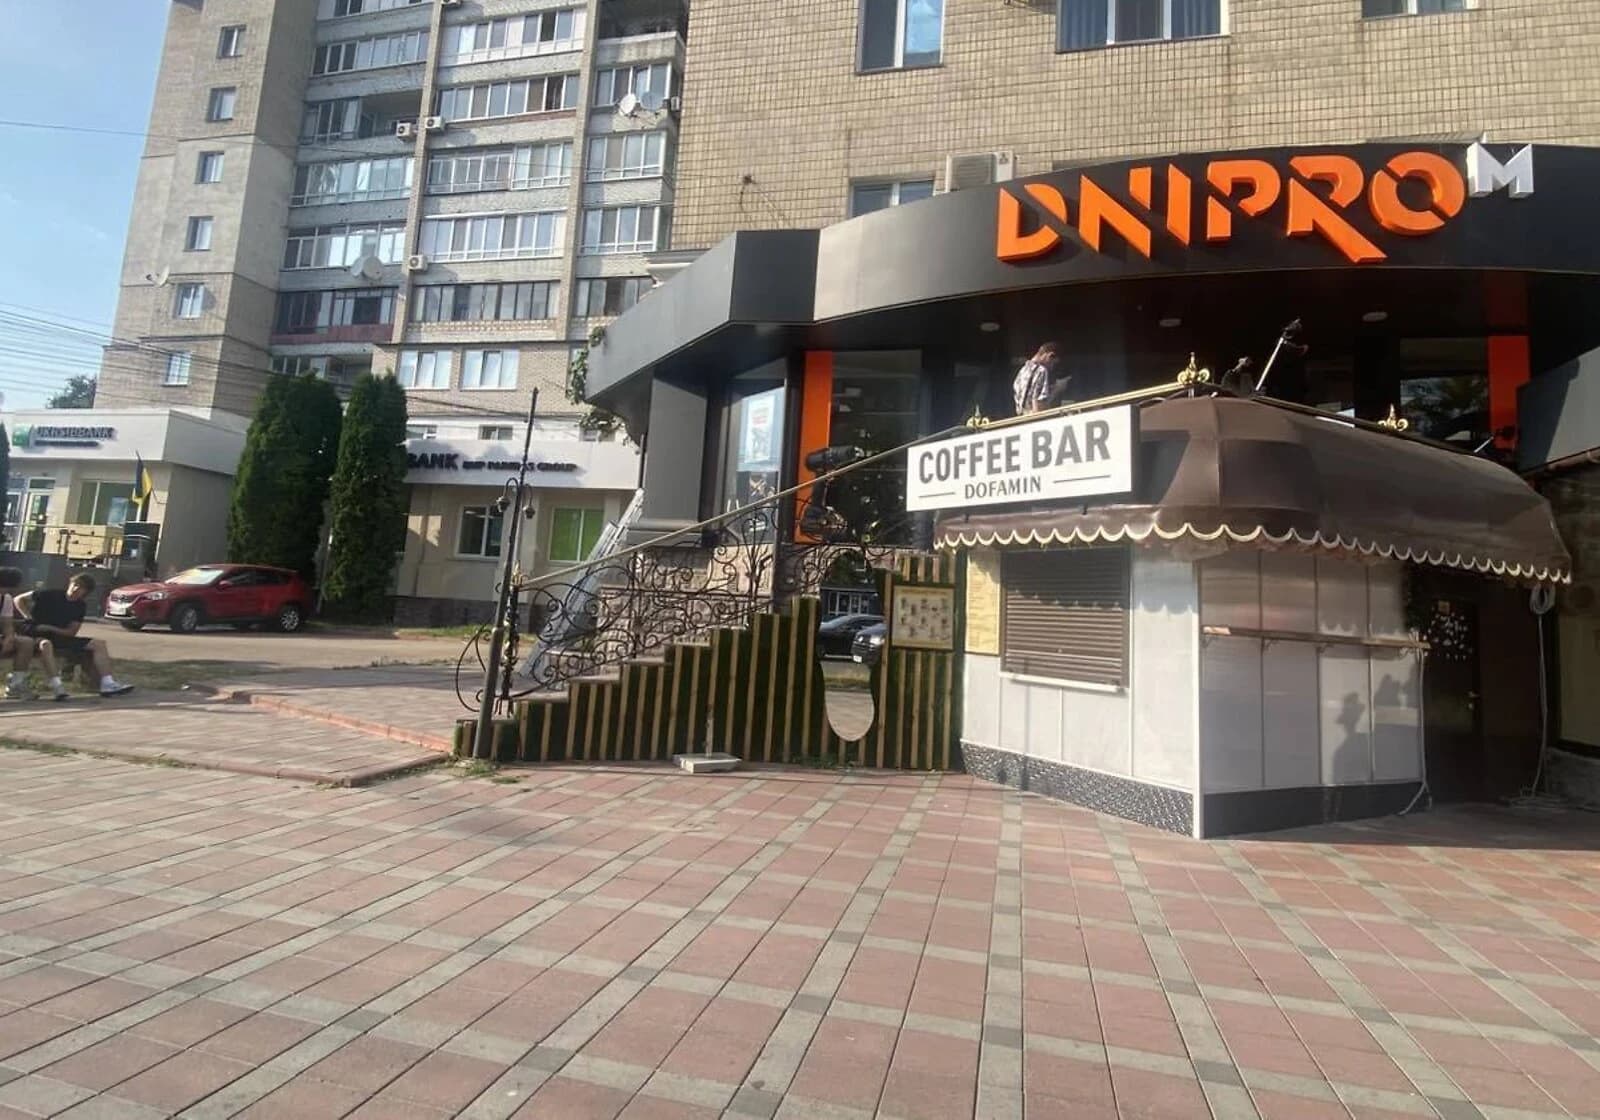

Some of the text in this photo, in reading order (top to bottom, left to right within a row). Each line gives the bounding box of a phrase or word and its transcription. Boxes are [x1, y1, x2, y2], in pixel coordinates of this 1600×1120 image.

[996, 151, 1466, 264] DNIPRO
[918, 419, 1112, 484] COFFEE BAR
[964, 475, 1042, 500] DOFAMIN
